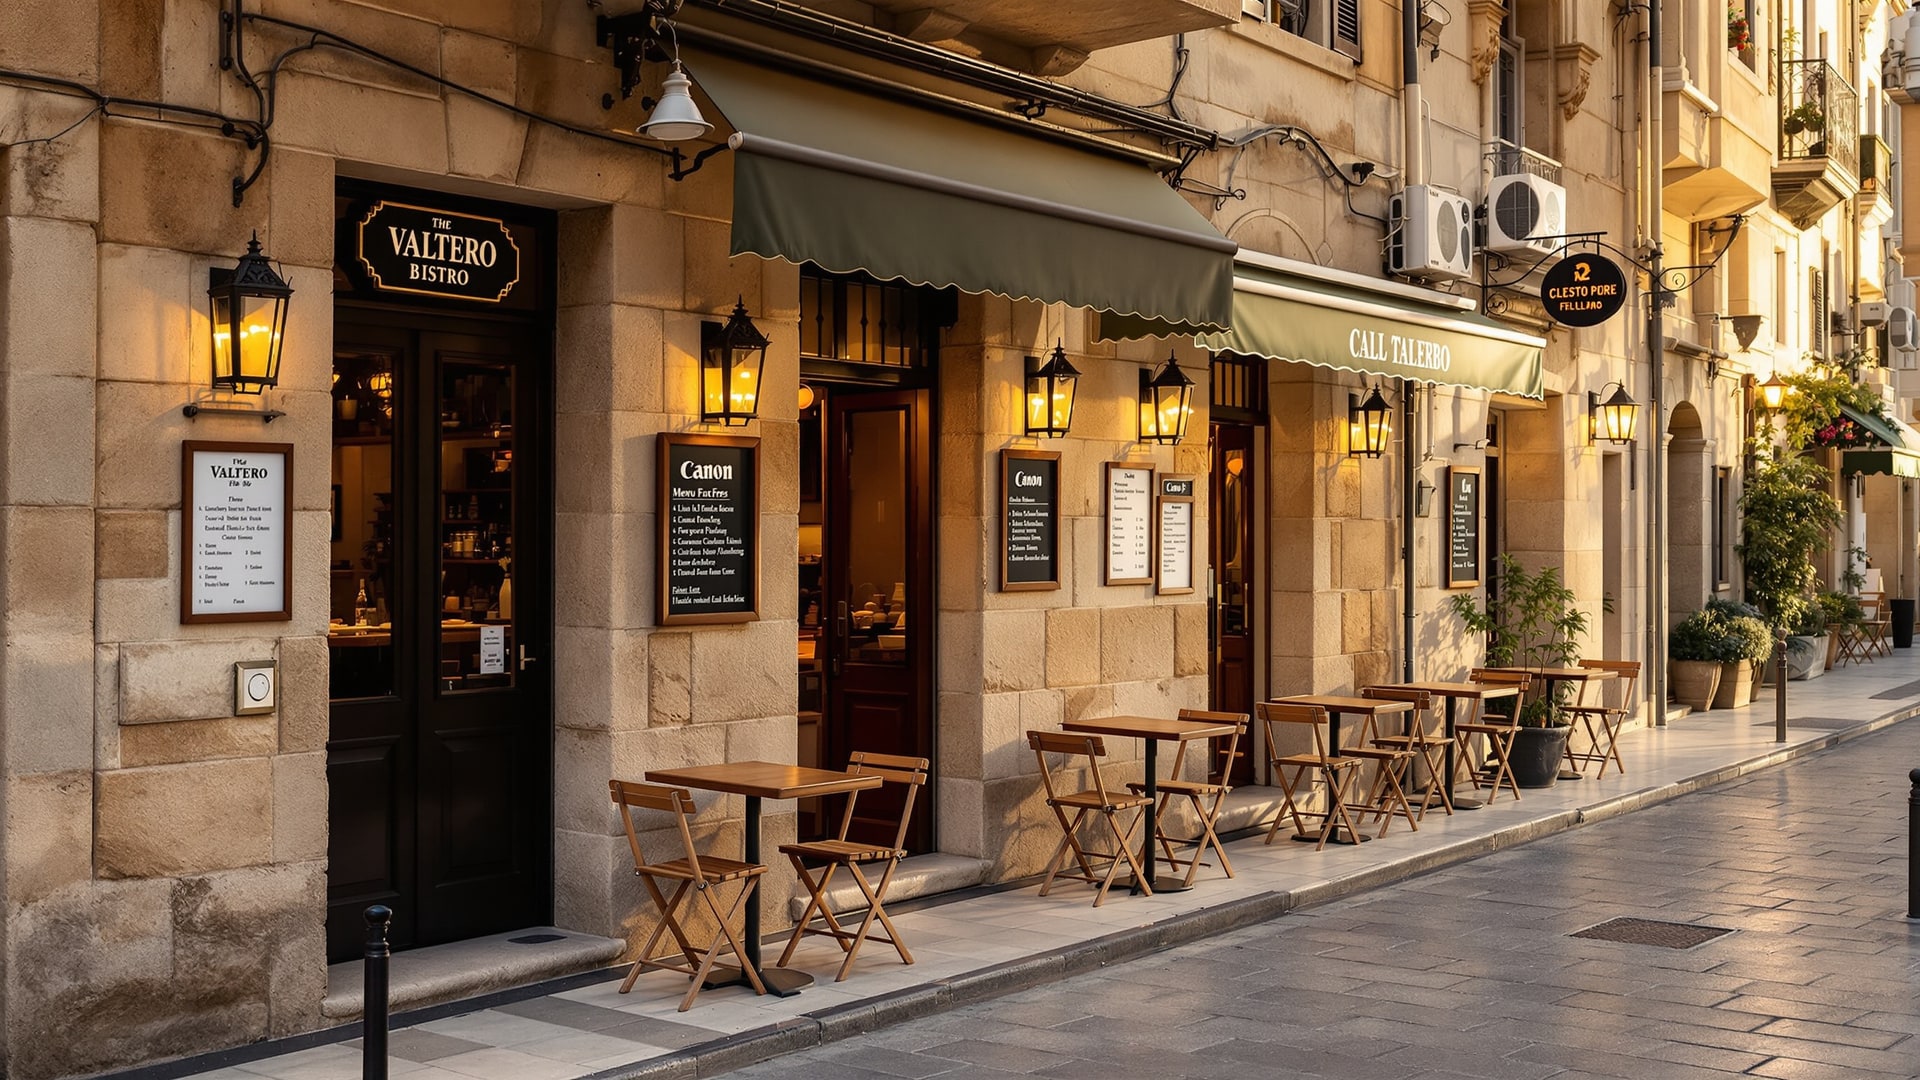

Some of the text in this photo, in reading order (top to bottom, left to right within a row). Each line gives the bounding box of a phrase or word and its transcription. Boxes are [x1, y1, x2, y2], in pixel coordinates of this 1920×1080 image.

[432, 217, 452, 230] THE
[388, 226, 497, 268] VALTERO
[409, 263, 469, 286] BISTRO
[1549, 286, 1588, 300] CLESTO
[1349, 328, 1450, 372] CALL TALERBO
[211, 465, 268, 479] VALTERO
[680, 460, 733, 480] Canon
[1015, 471, 1042, 487] Canon
